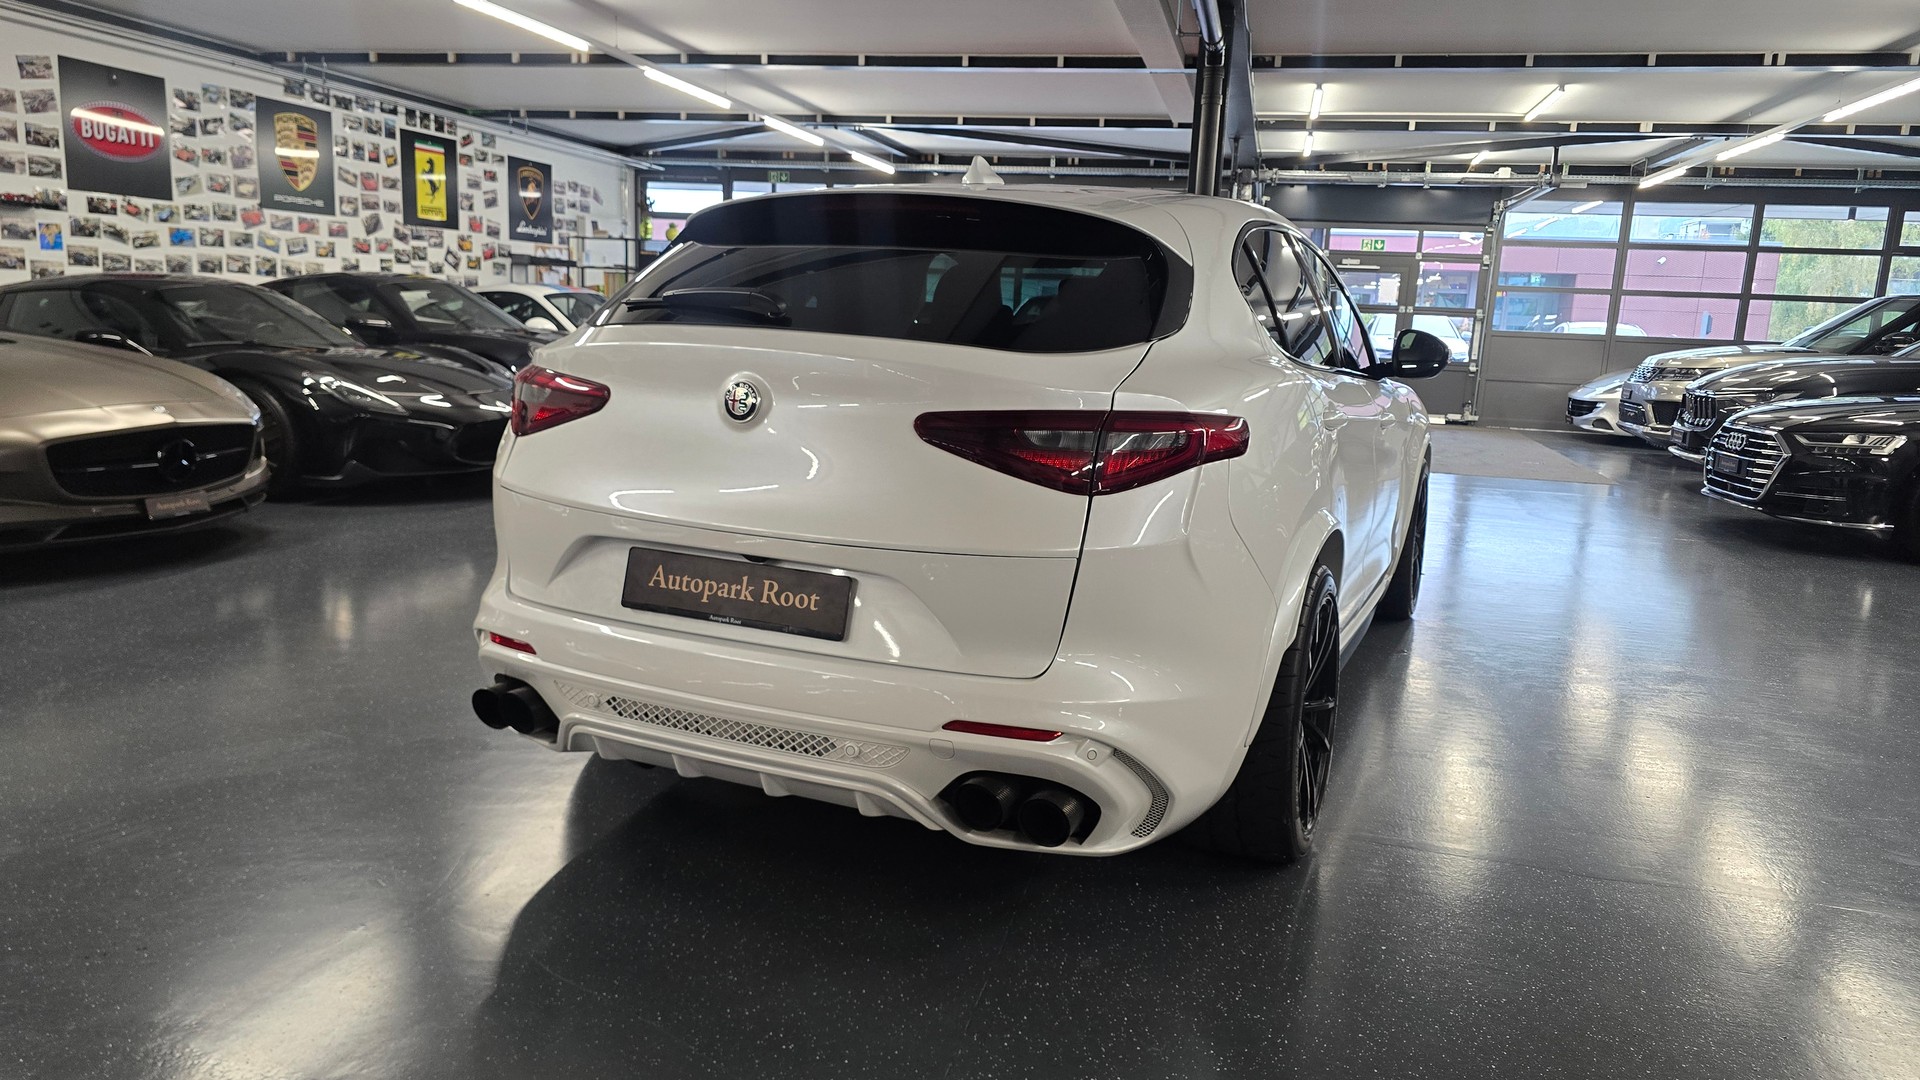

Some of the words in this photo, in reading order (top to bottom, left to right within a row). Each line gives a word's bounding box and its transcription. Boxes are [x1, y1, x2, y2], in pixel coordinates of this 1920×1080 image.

[81, 117, 154, 148] BUGATTI
[648, 564, 754, 603] Autopark
[760, 579, 820, 611] Root
